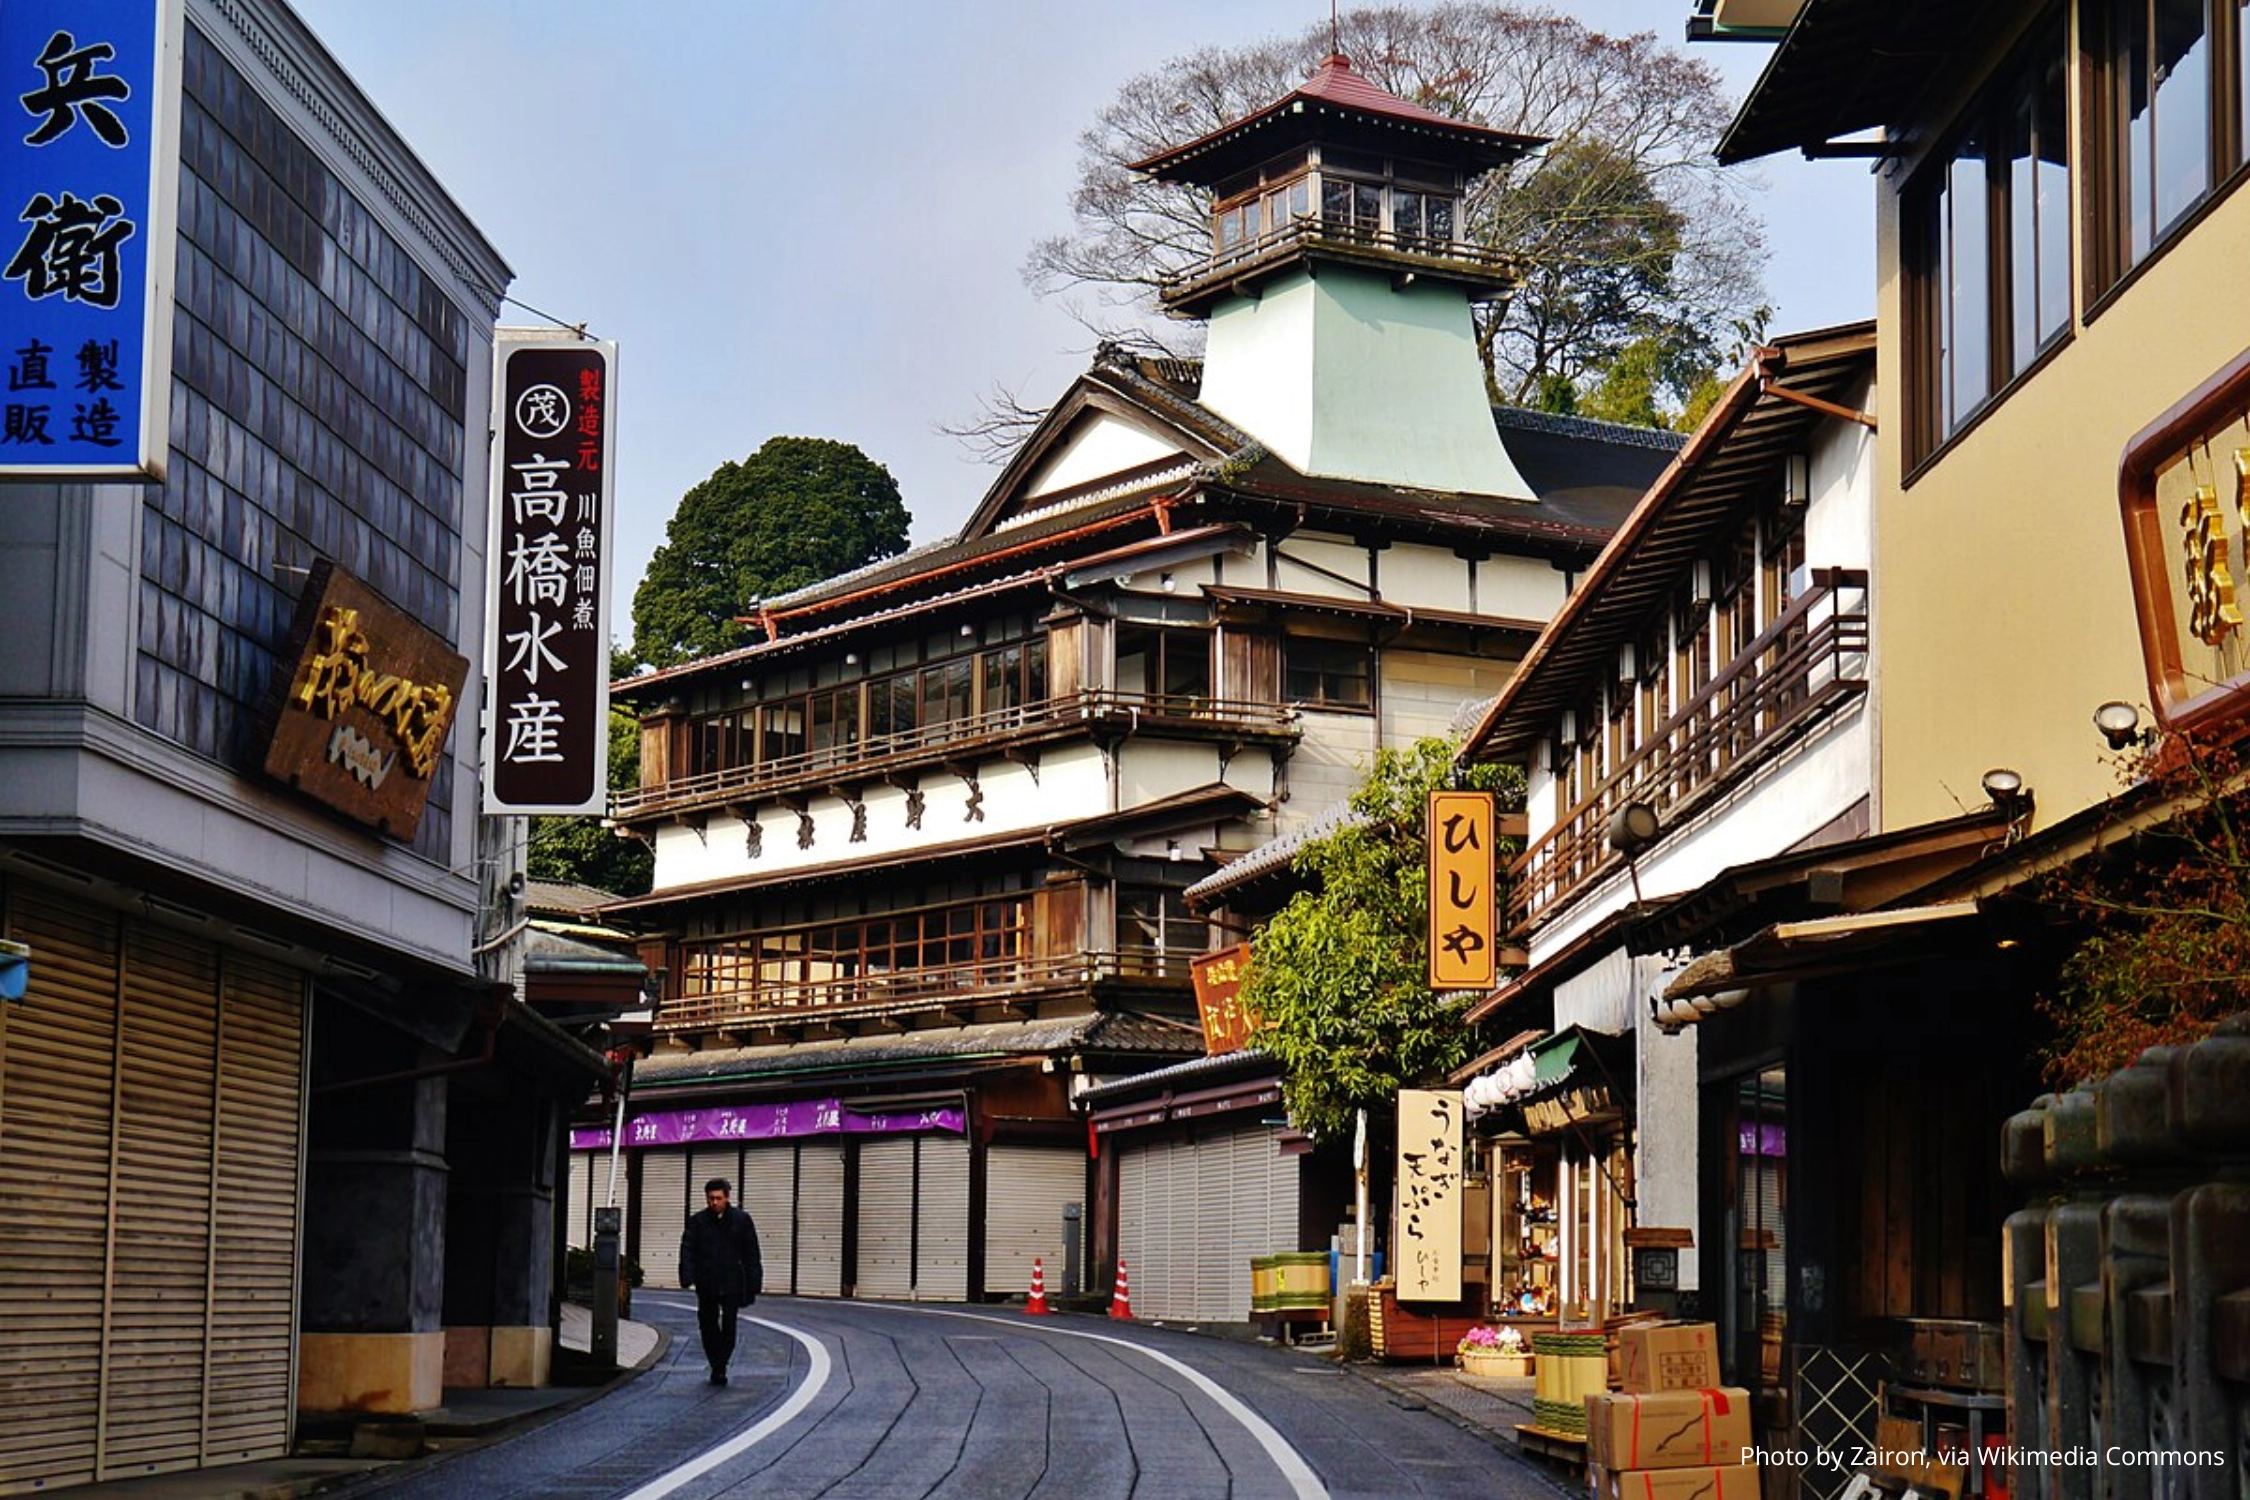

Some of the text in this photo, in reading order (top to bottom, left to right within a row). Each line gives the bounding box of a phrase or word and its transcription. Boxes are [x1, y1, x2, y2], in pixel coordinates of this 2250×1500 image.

[3, 30, 135, 309] 兵衛
[1, 338, 57, 445] 直販
[69, 338, 126, 448] 製造
[577, 368, 601, 471] 製造元
[502, 453, 572, 764] 高橋水産
[571, 492, 597, 631] 川魚佃煮
[1442, 813, 1485, 965] ひしや
[1402, 1152, 1430, 1240] 天ぷら
[1430, 1098, 1460, 1200] うなぎ
[1417, 1249, 1430, 1294] ひしや
